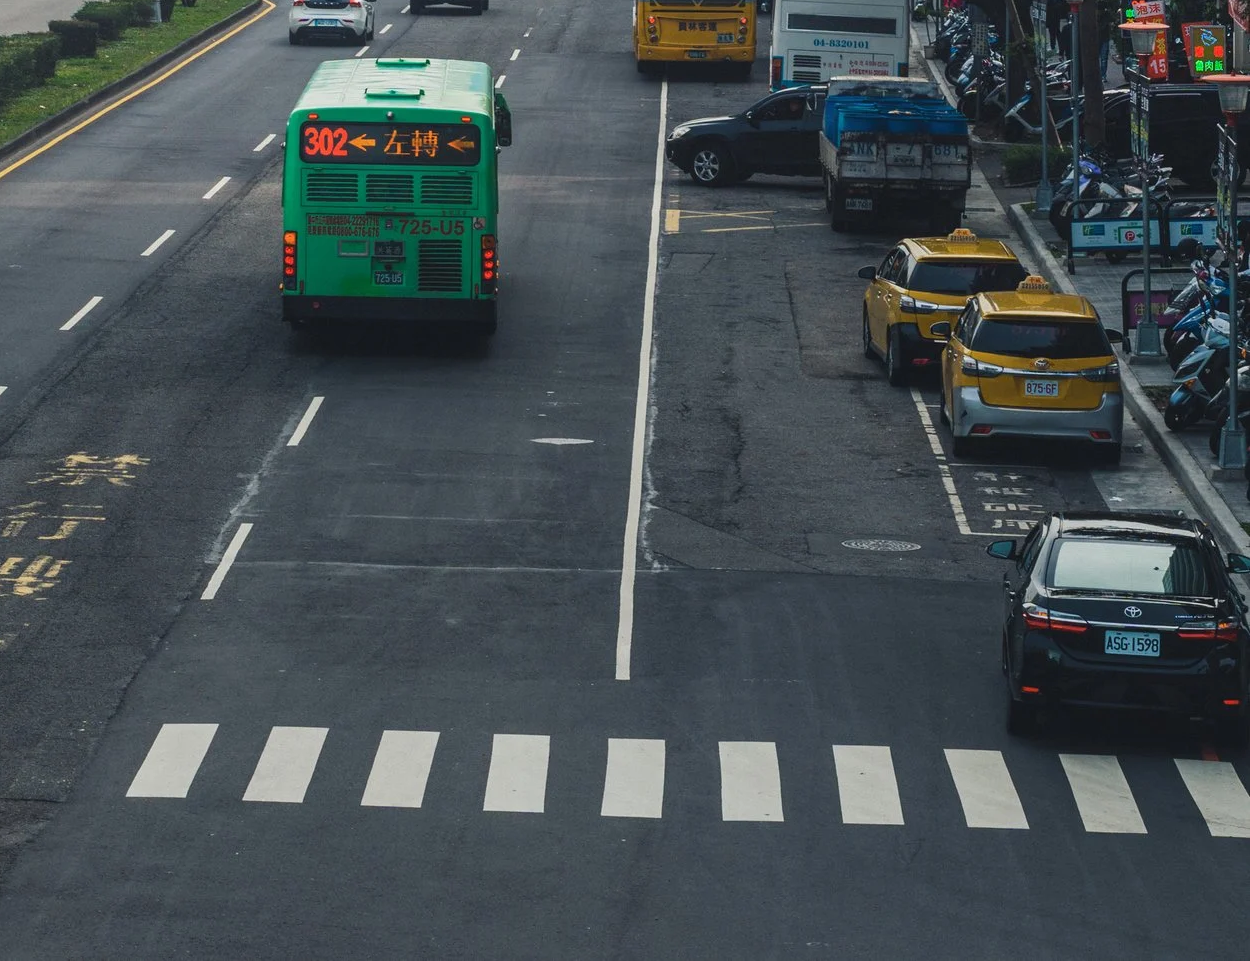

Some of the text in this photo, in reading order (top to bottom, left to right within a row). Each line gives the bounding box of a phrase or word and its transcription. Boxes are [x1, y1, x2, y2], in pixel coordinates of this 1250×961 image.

[1136, 3, 1161, 18] 泡沫
[813, 39, 870, 50] 04-8320101
[1194, 60, 1223, 72] 魯肉飯
[304, 127, 439, 157] 302 左轉
[399, 219, 465, 236] 725-U5
[375, 272, 403, 284] 725-U5
[1026, 382, 1057, 396] 875-6F
[1106, 636, 1160, 654] ASG-1598
